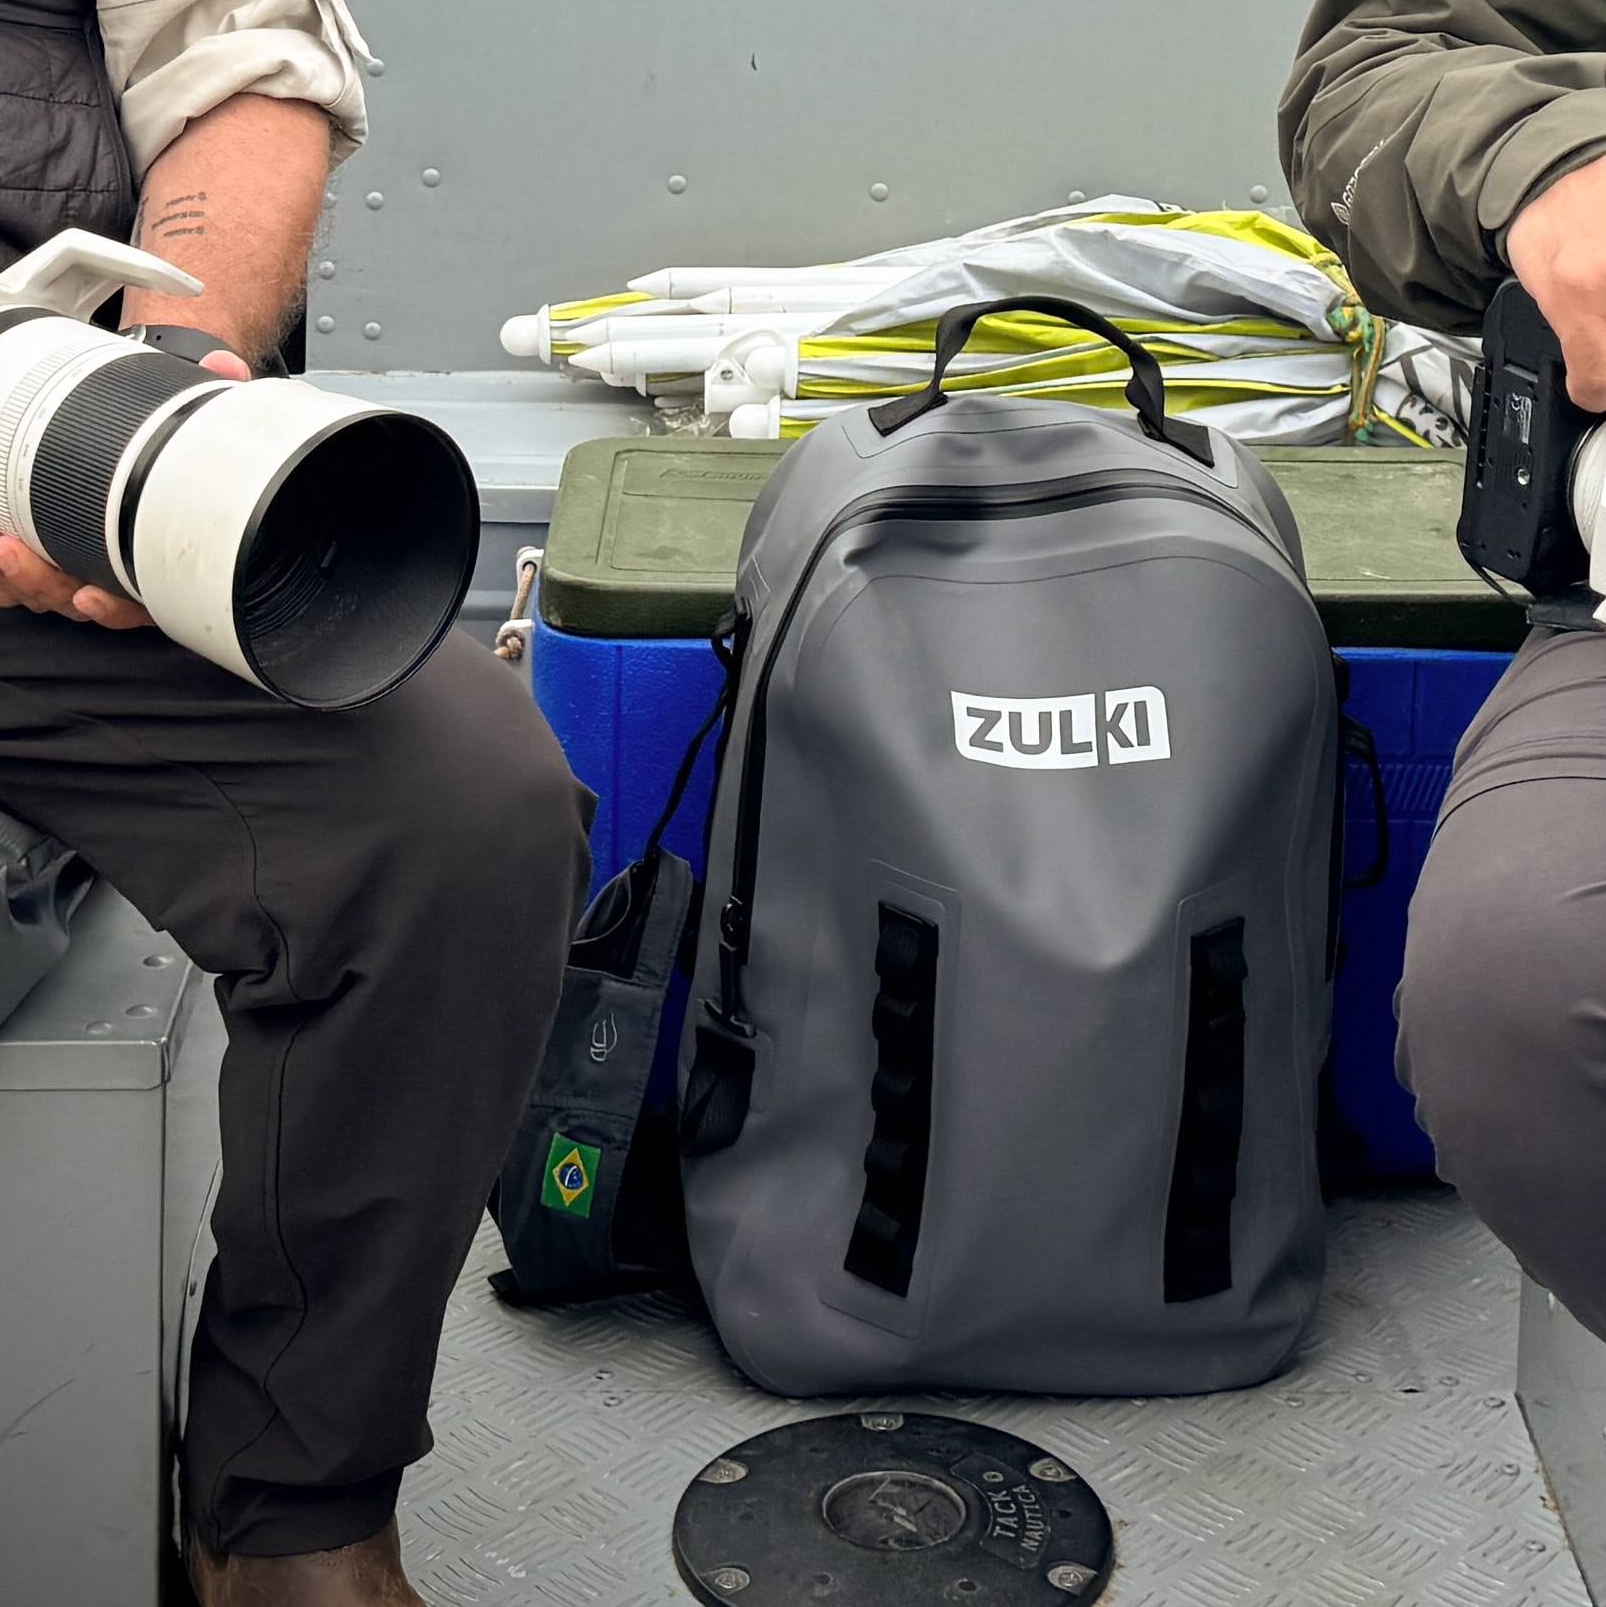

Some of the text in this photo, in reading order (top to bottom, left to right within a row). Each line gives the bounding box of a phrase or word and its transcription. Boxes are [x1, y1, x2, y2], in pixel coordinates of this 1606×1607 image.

[966, 700, 1151, 755] ZULKI
[986, 1490, 1019, 1538] TACK
[1012, 1484, 1045, 1551] NAUTICA
